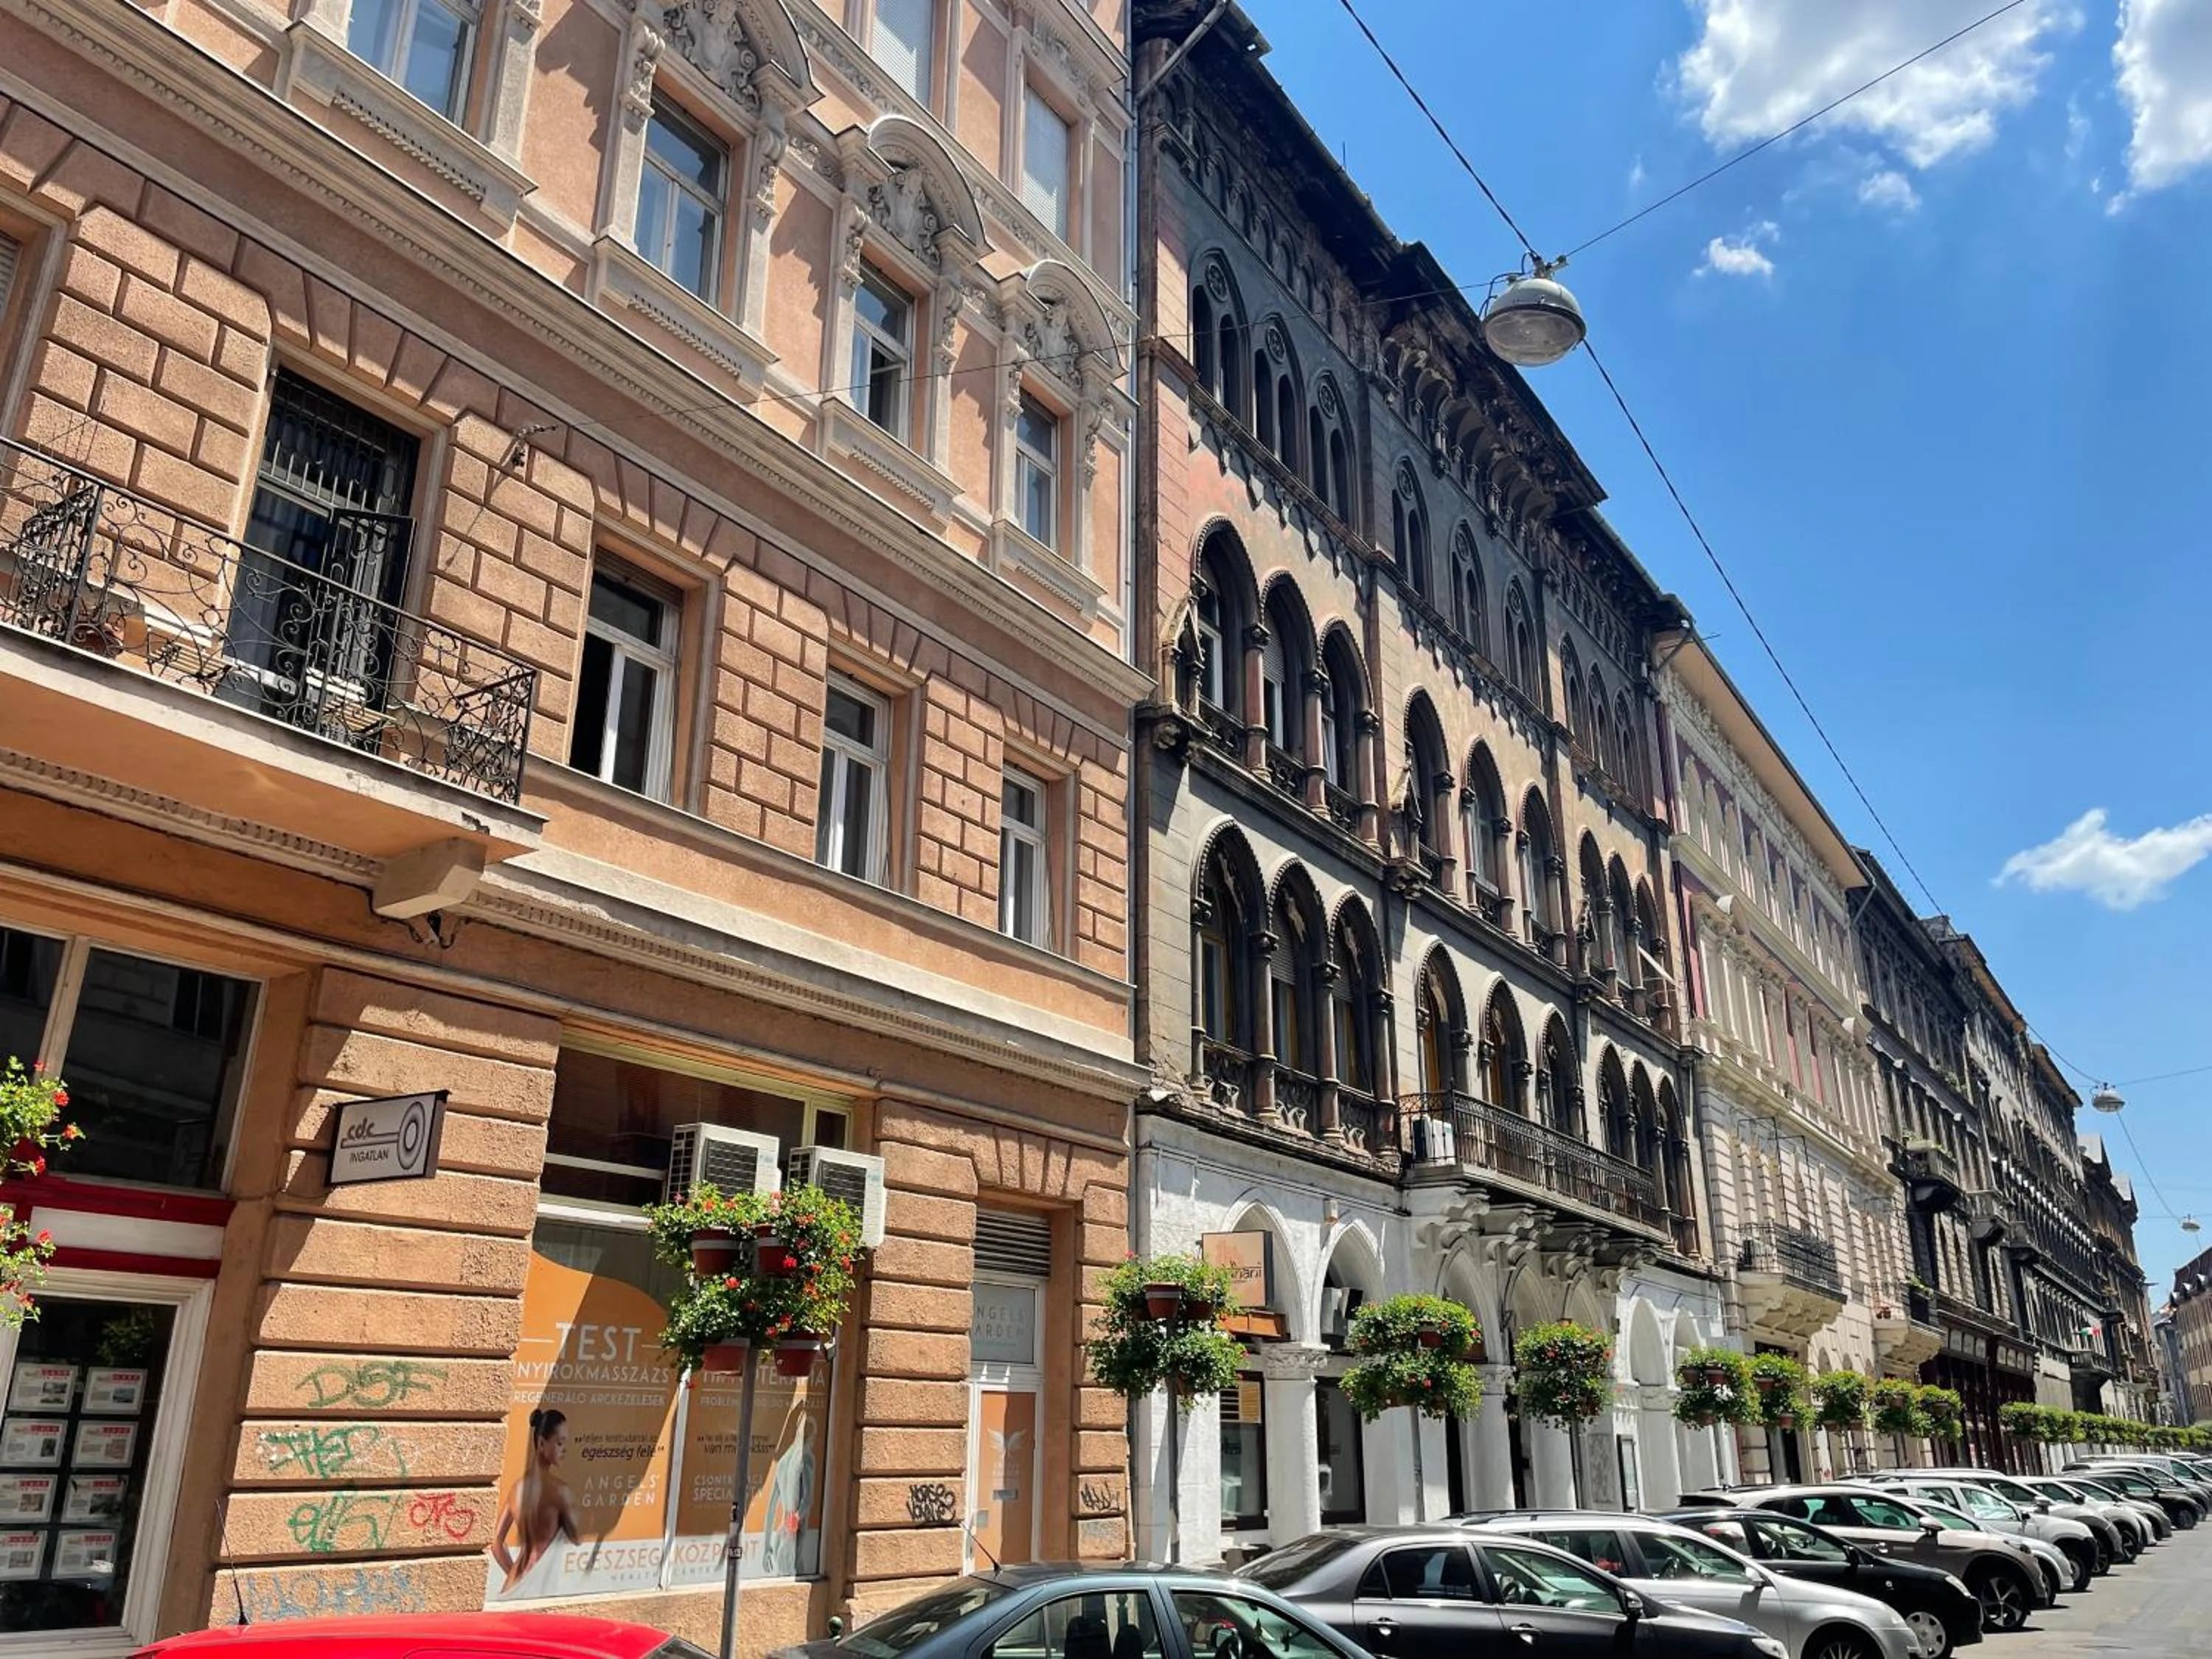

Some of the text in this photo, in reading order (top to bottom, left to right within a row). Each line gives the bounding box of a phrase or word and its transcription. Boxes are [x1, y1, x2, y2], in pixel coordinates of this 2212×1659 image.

[347, 1117, 375, 1141] cdc
[349, 1149, 390, 1164] INGATLAN
[975, 1324, 1024, 1339] ARDEN
[555, 1321, 642, 1362] TEST
[581, 1490, 655, 1508] GARDEN
